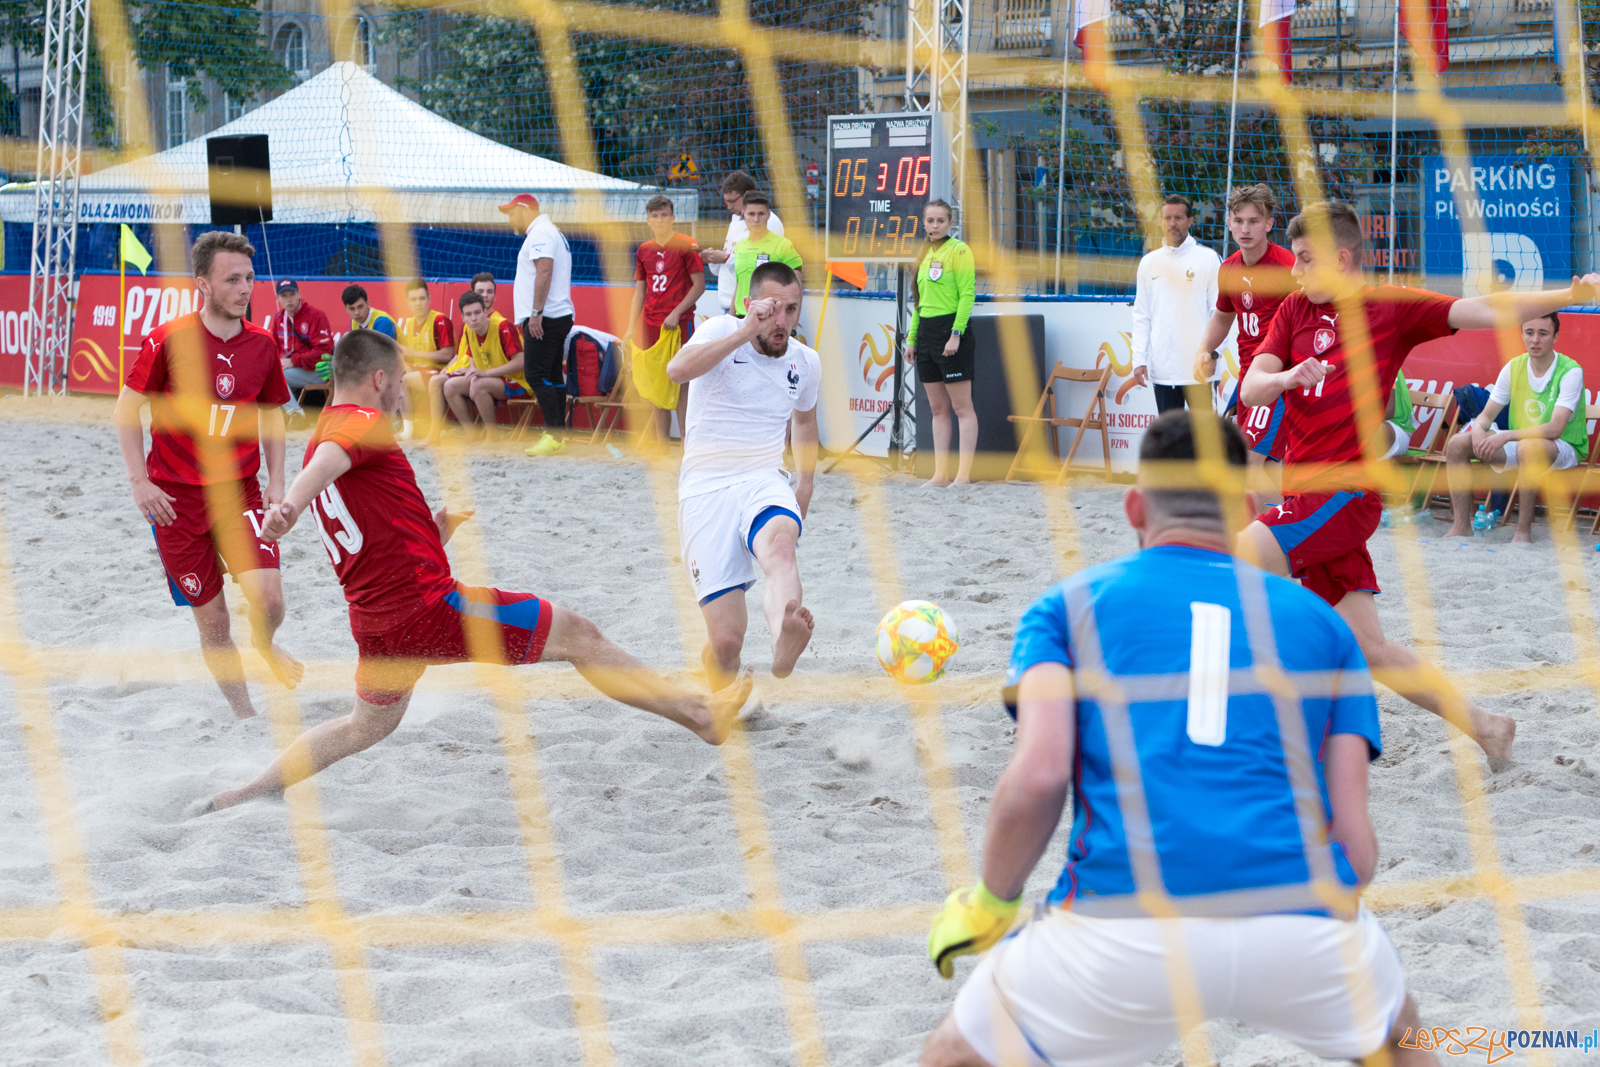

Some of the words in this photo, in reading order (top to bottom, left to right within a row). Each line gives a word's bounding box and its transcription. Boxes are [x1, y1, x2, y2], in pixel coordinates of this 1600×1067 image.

[833, 122, 851, 130] NAZWA
[852, 121, 875, 130] DRUŻYNY
[886, 120, 904, 128] NAZWA
[905, 118, 930, 127] DRUŻYNY
[834, 158, 868, 197] 05
[876, 162, 888, 191] 3
[895, 156, 931, 196] 06
[1435, 163, 1556, 193] PARKING
[869, 200, 890, 213] TIME
[1435, 199, 1459, 219] Pl.
[1465, 196, 1560, 219] Wolności
[843, 215, 918, 255] 01:32
[1360, 214, 1397, 239] URO
[652, 274, 667, 293] 22
[92, 304, 117, 327] 1919
[849, 398, 875, 413] BEACH
[1247, 405, 1271, 429] 10
[208, 404, 236, 436] 17
[1111, 438, 1129, 449] PZPN
[1186, 601, 1231, 747] 1
